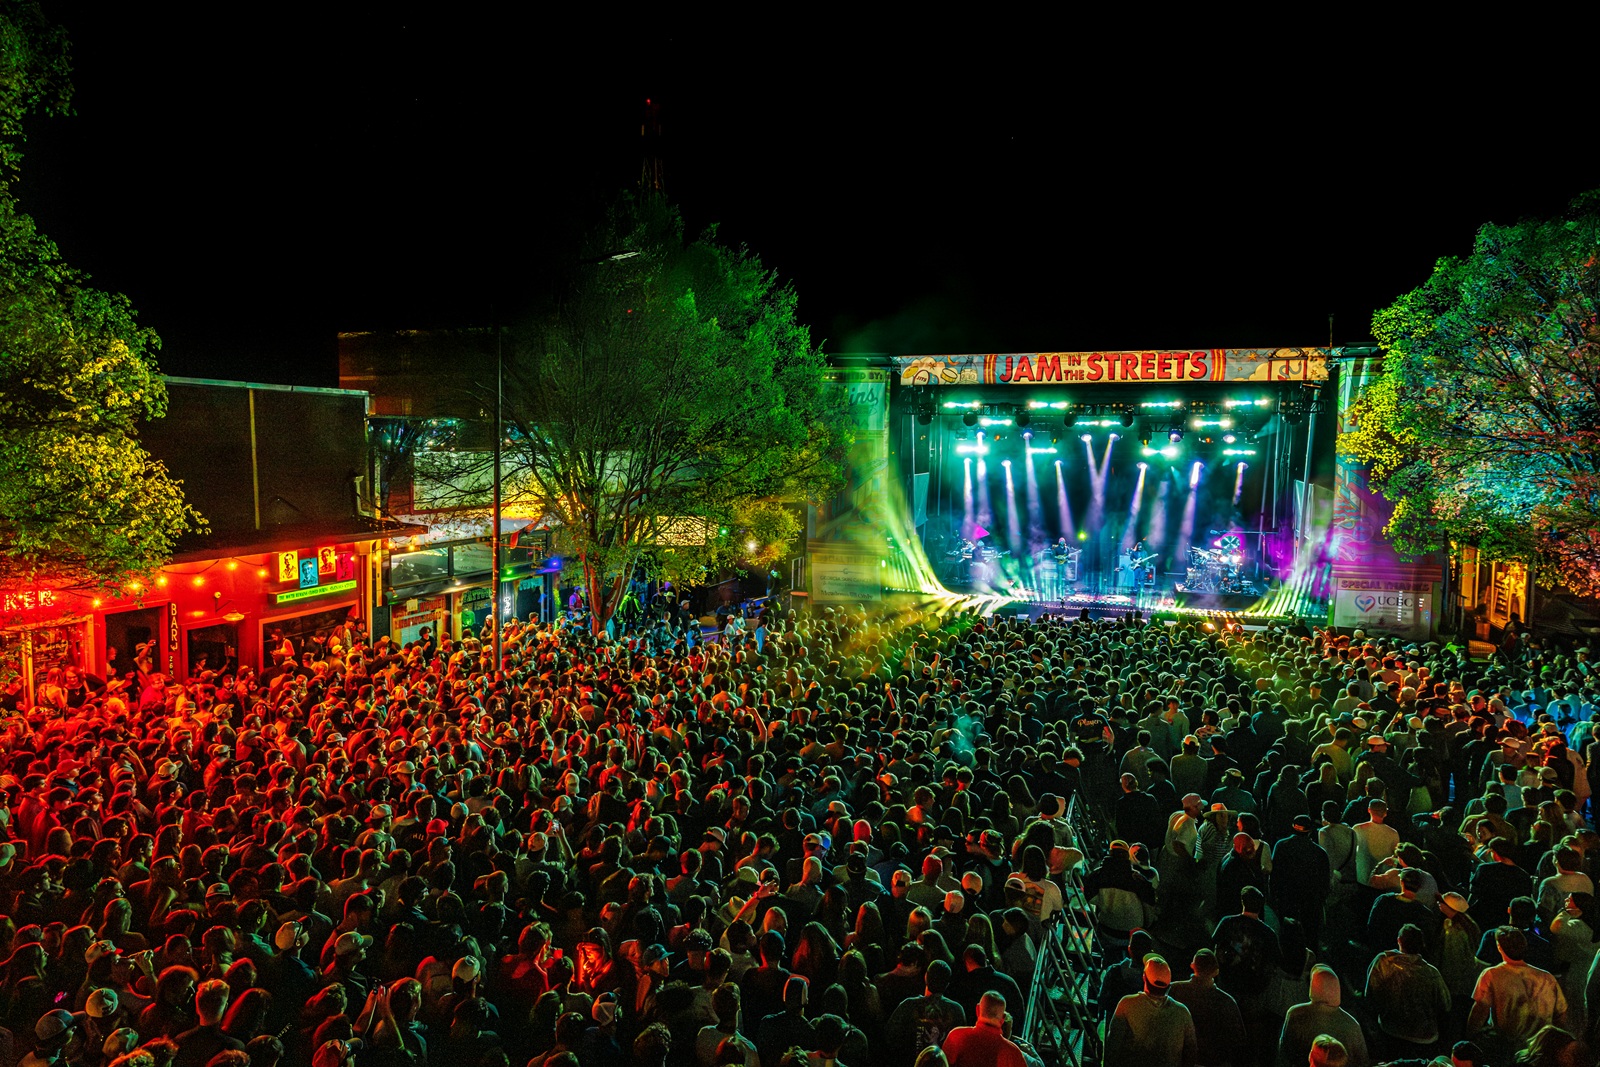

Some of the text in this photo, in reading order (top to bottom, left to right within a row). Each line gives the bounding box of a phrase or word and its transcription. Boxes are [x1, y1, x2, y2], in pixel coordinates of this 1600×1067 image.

[999, 350, 1208, 382] JAM IN THE STREETS
[1341, 580, 1381, 589] SPECIAL
[170, 603, 179, 642] BAR
